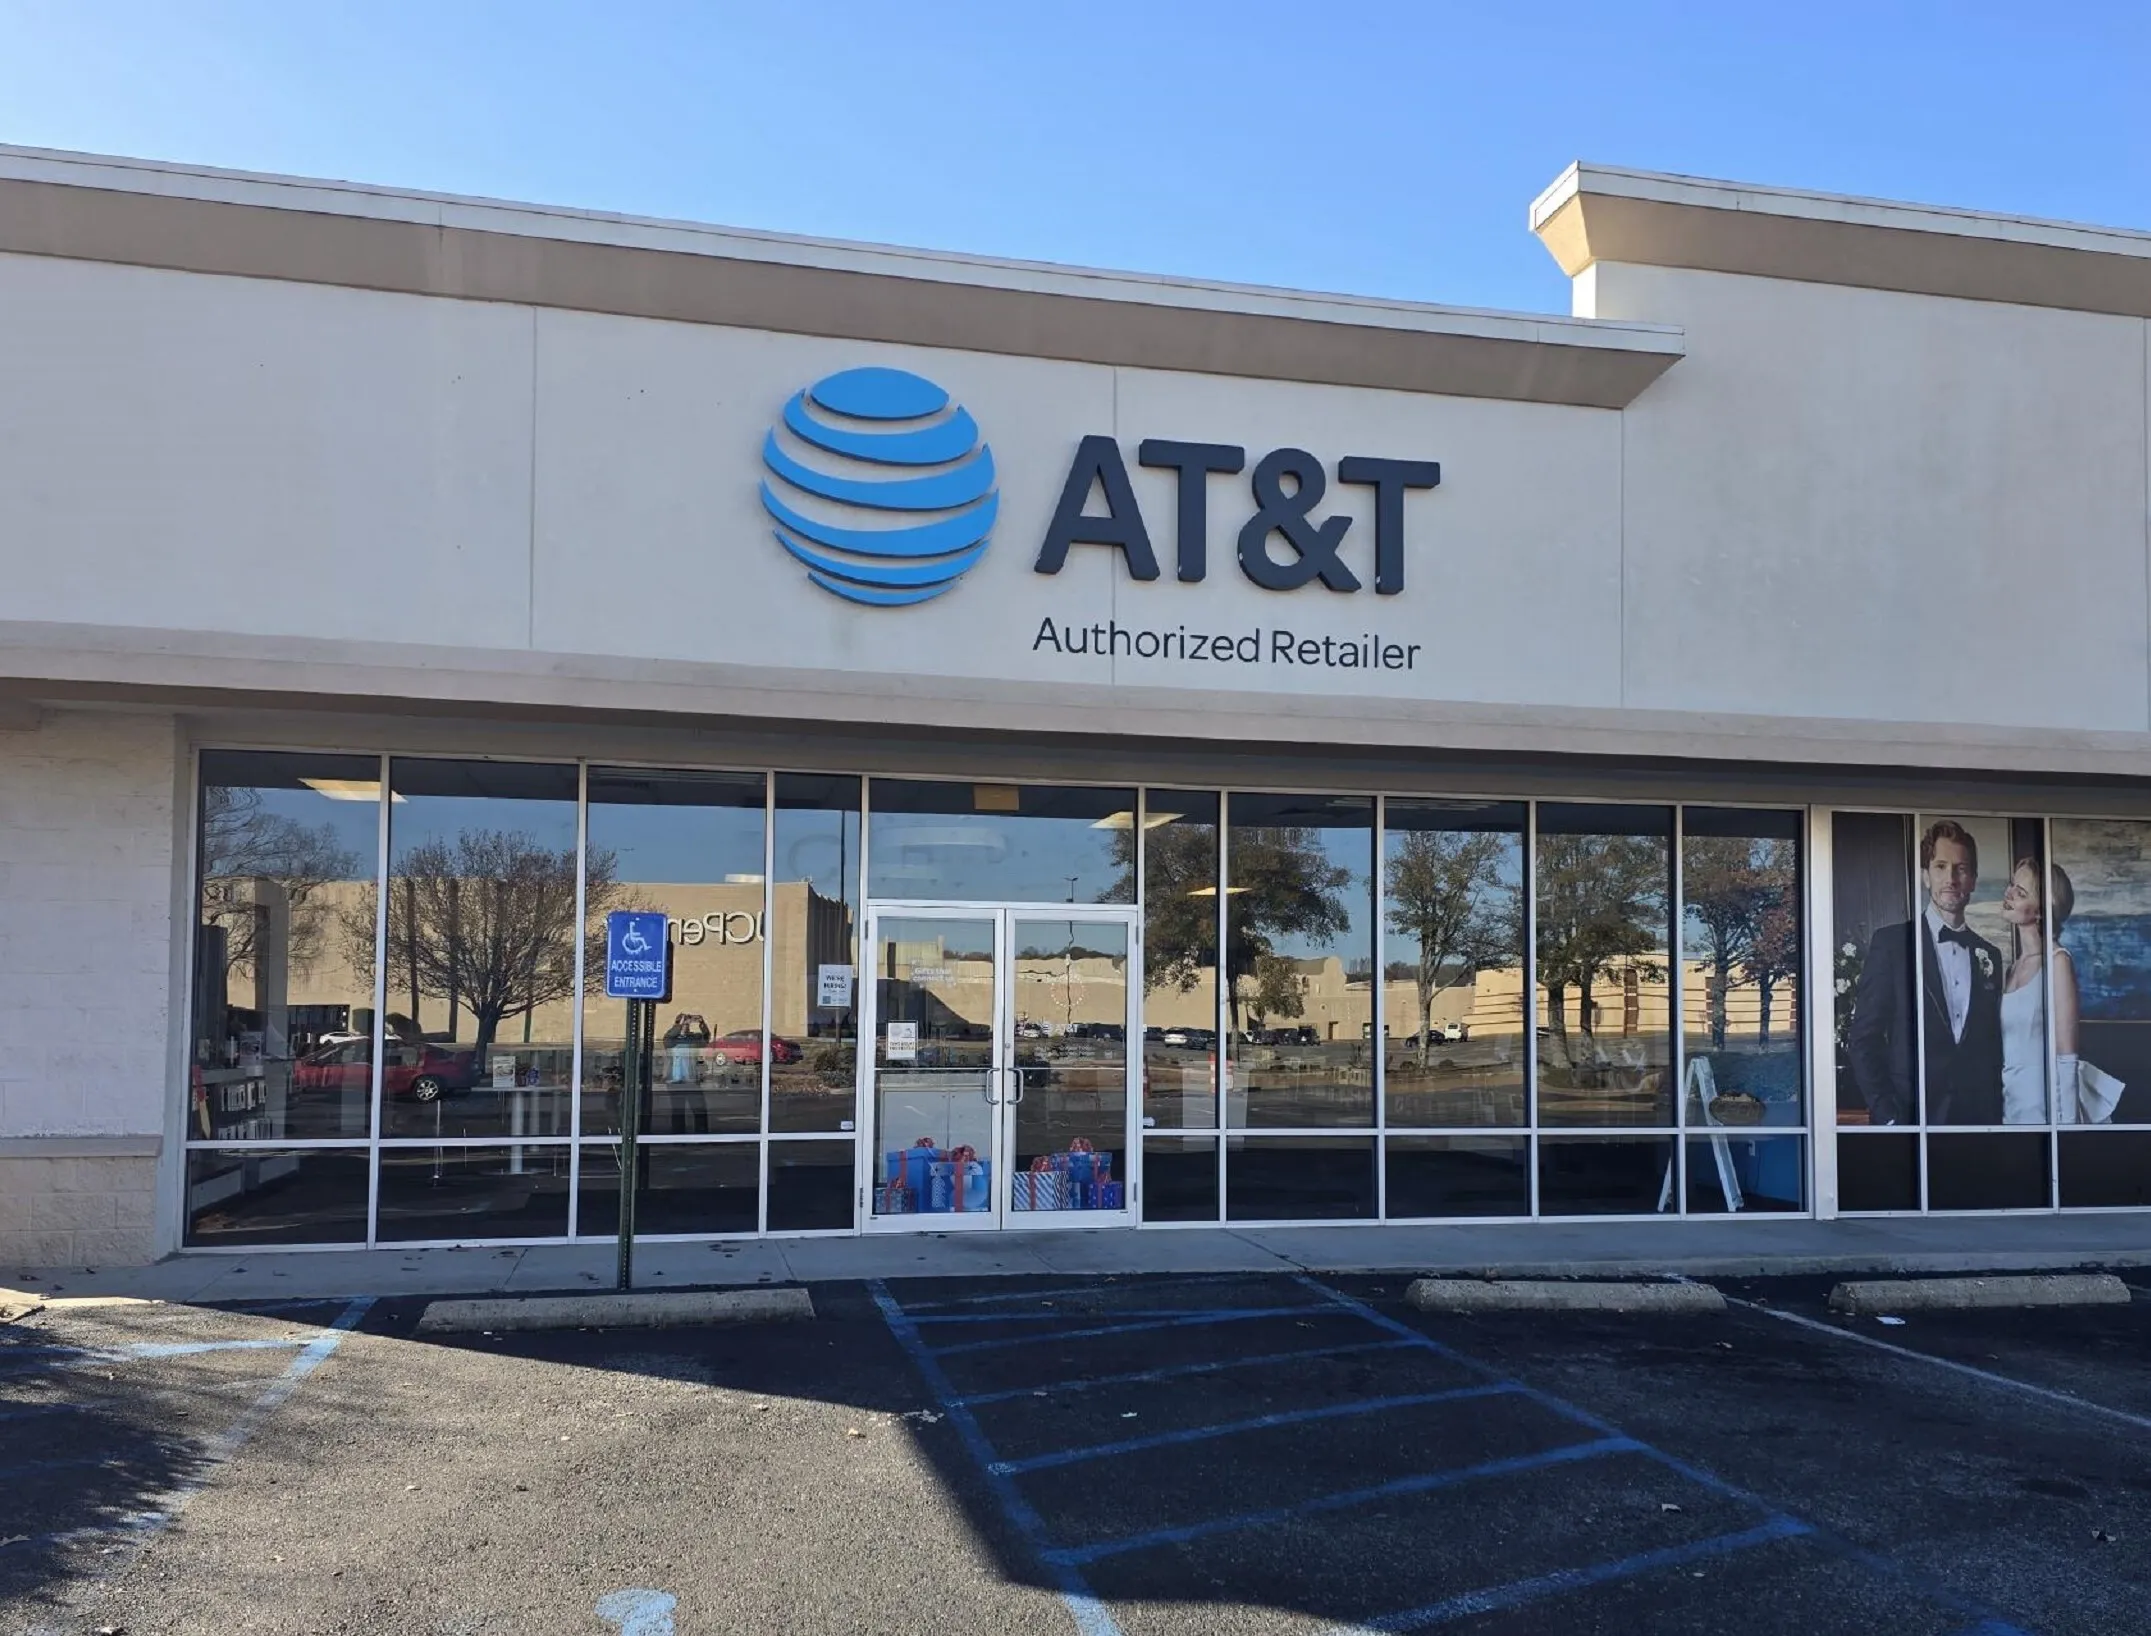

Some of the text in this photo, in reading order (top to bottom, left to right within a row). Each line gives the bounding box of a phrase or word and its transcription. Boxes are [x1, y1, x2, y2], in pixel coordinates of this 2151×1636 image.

[1034, 434, 1440, 595] AT&T
[1033, 616, 1421, 670] Authorized Retailer
[611, 960, 662, 972] ACCESSIBLE
[614, 976, 658, 988] ENTRANCE
